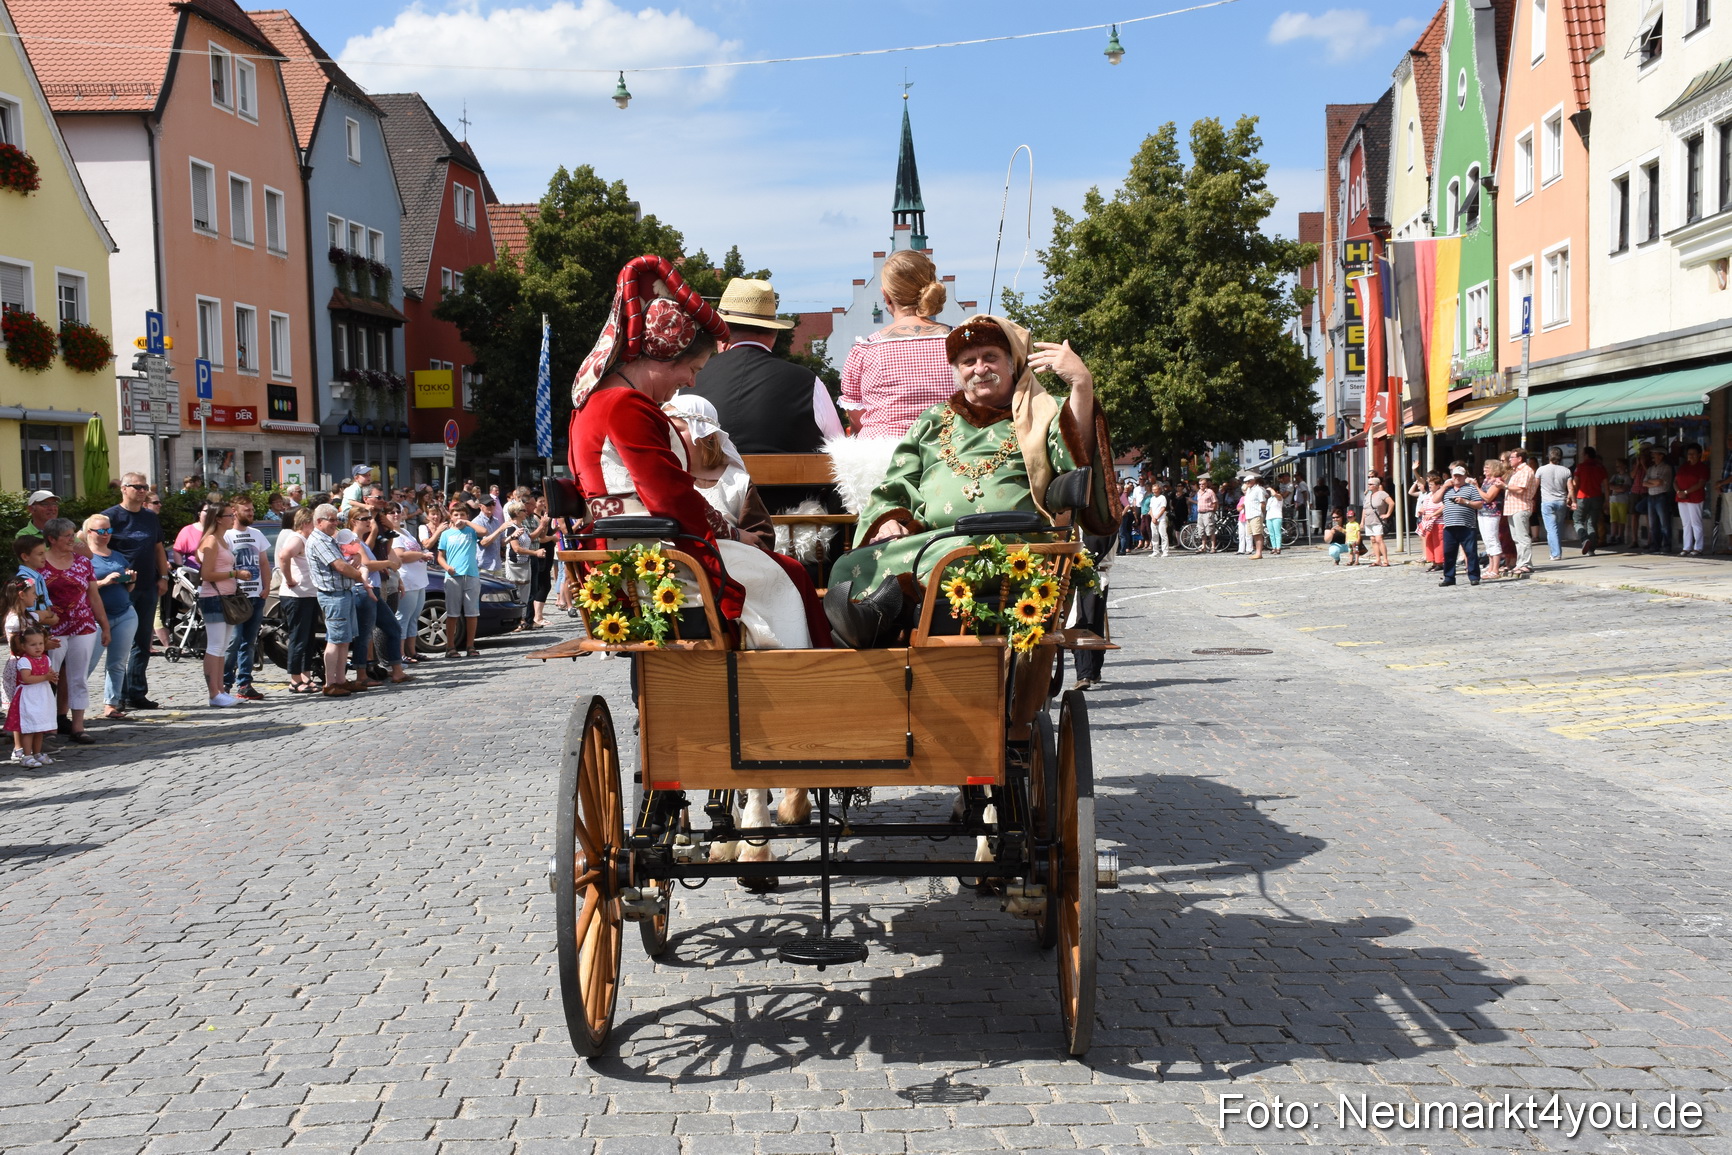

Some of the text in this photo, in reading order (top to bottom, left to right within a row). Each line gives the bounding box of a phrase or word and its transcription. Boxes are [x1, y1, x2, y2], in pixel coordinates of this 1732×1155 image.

[1346, 243, 1367, 371] HOTEL
[1523, 301, 1529, 330] P
[150, 316, 160, 349] P
[199, 364, 209, 394] P
[418, 384, 450, 392] TAKKO
[122, 379, 131, 430] KINO
[235, 410, 253, 420] DER
